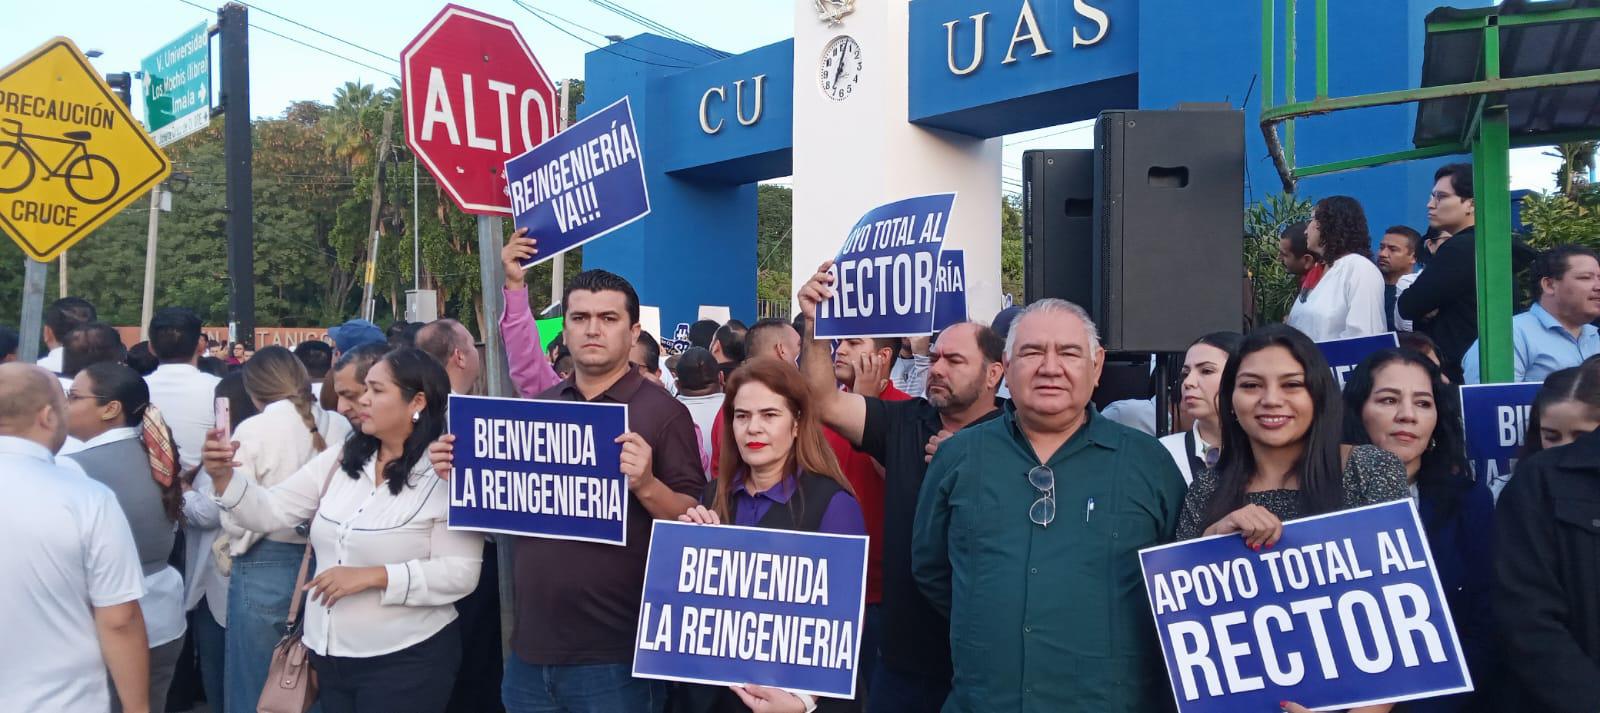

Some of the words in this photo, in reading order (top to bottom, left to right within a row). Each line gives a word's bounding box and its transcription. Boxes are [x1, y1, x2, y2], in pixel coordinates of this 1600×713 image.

[164, 31, 208, 68] Universidad
[853, 50, 860, 60] 2
[942, 0, 1112, 77] UAS
[151, 84, 164, 101] Los
[163, 71, 186, 95] Mochis
[186, 55, 208, 82] (libre)
[823, 70, 829, 79] 9
[825, 81, 831, 90] 8
[847, 84, 852, 93] 5
[852, 74, 858, 84] 4
[857, 61, 862, 71] 3
[172, 89, 195, 113] Imala
[420, 66, 550, 154] ALTO
[698, 73, 766, 135] CU
[838, 88, 844, 98] 6
[511, 119, 637, 217] REINGENIERÍA
[11, 199, 78, 228] CRUCE
[551, 181, 602, 234] VA!!!
[842, 223, 872, 255] OYO
[871, 213, 916, 251] TOTAL
[917, 211, 943, 243] AL
[820, 250, 936, 319] RECTOR
[255, 331, 332, 347] TANICO
[474, 417, 597, 467] BIENVENIDA
[449, 466, 477, 509] LA
[480, 469, 623, 522] REINGENIERIA
[677, 546, 829, 606] BIENVENIDA
[1152, 556, 1260, 615] APOYO
[1259, 537, 1373, 594] TOTAL
[1376, 528, 1427, 575] AL
[638, 601, 672, 653] LA
[678, 606, 854, 670] REINGENIERIA
[1167, 581, 1449, 703] RECTOR
